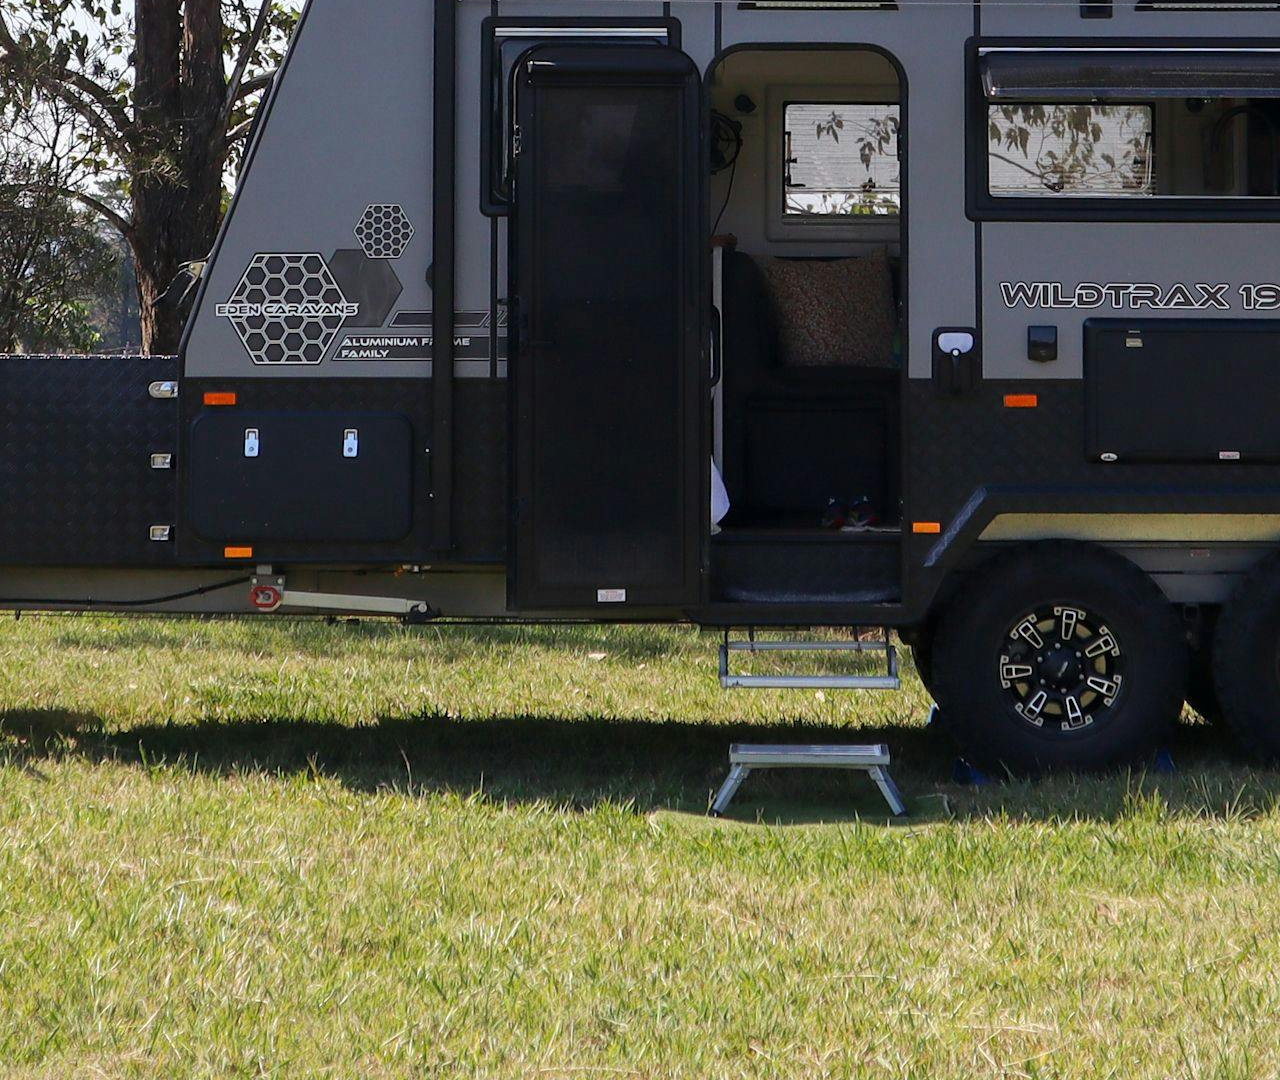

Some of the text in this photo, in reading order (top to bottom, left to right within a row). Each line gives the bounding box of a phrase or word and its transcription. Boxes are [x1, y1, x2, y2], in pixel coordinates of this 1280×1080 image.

[1000, 282, 1230, 309] WILDTRAX
[216, 304, 358, 317] EDEN CARAVANS
[341, 337, 471, 347] ALUMINIUM FME
[341, 349, 390, 358] FAMILY
